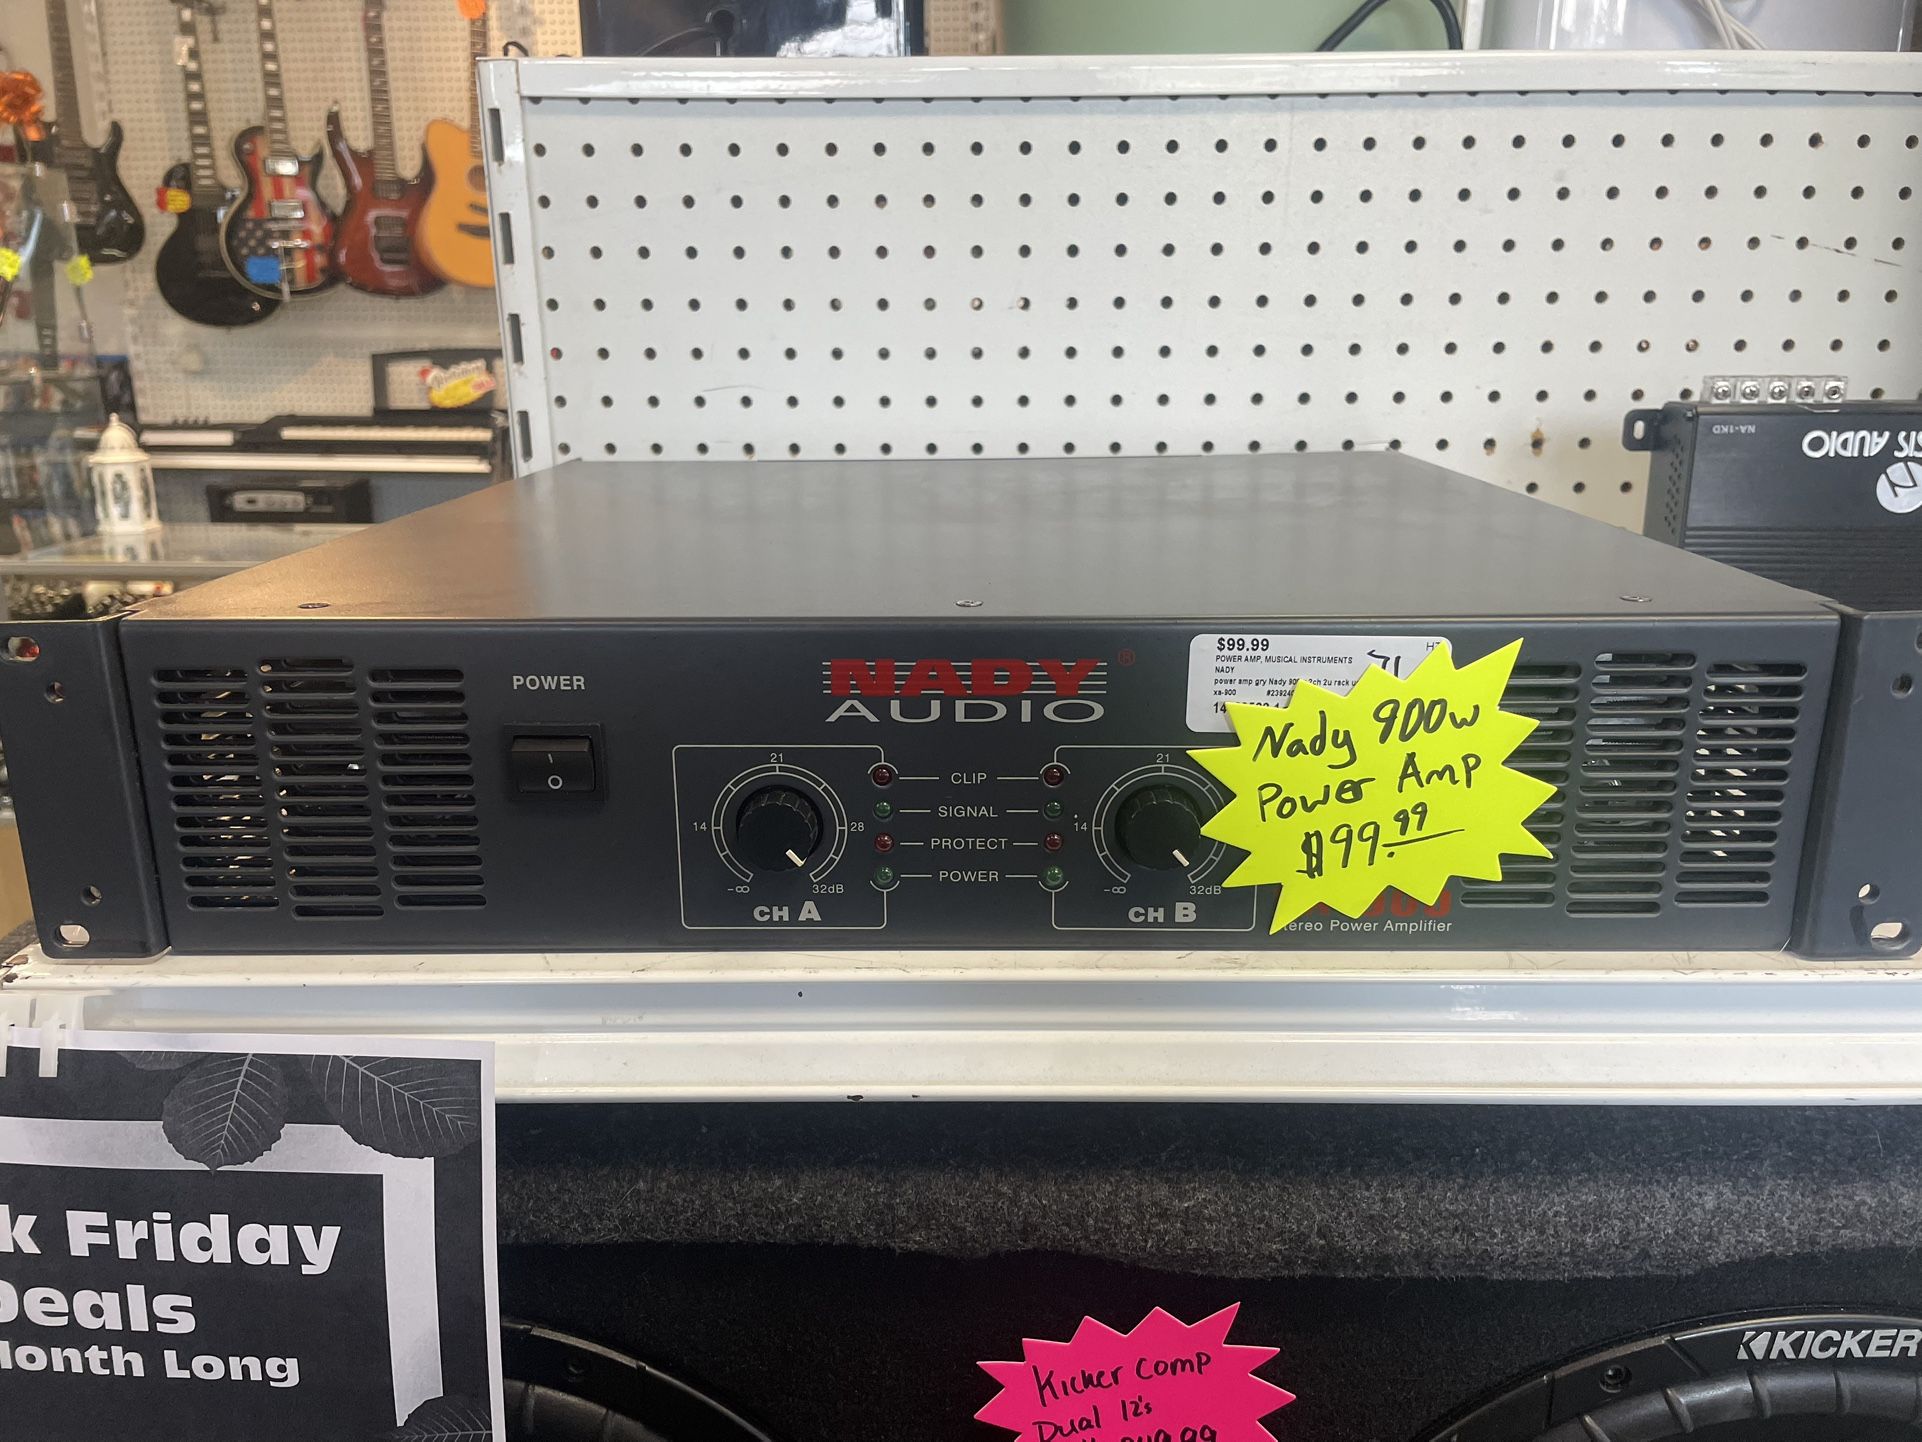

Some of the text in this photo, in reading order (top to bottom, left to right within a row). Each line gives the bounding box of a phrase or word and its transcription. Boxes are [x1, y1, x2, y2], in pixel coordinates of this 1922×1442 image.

[1801, 430, 1890, 458] AUDIO
[1216, 637, 1270, 652] $99.99
[1215, 655, 1353, 664] POWER AMP, MUSICAL INSTRUMENTS
[1215, 666, 1235, 674] NADY
[512, 675, 586, 690] POWER
[827, 658, 1103, 697] NADY
[1214, 678, 1236, 687] power
[1238, 679, 1253, 687] amp
[1269, 678, 1287, 687] Nady
[825, 699, 1105, 724] AUDIO
[1252, 710, 1358, 769] Nady
[769, 752, 785, 764] 21
[1155, 752, 1171, 764] 21
[950, 771, 988, 784] CLIP
[1257, 776, 1376, 822] Power
[938, 804, 999, 817] SIGNAL
[692, 821, 708, 833] 14
[849, 821, 866, 833] 28
[1072, 821, 1088, 833] 14
[930, 837, 1008, 850] PROTECT
[938, 870, 1000, 883] POWER
[812, 883, 845, 894] 32dB
[1189, 884, 1222, 896] 32dB
[753, 901, 822, 922] CH A
[1128, 902, 1198, 923] CH B
[1283, 919, 1452, 934] tereo Power Amplifier
[65, 1209, 342, 1275] Friday
[1768, 1329, 1922, 1359] KICKER
[163, 1349, 300, 1388] Long
[1032, 1404, 1102, 1442] Dual
